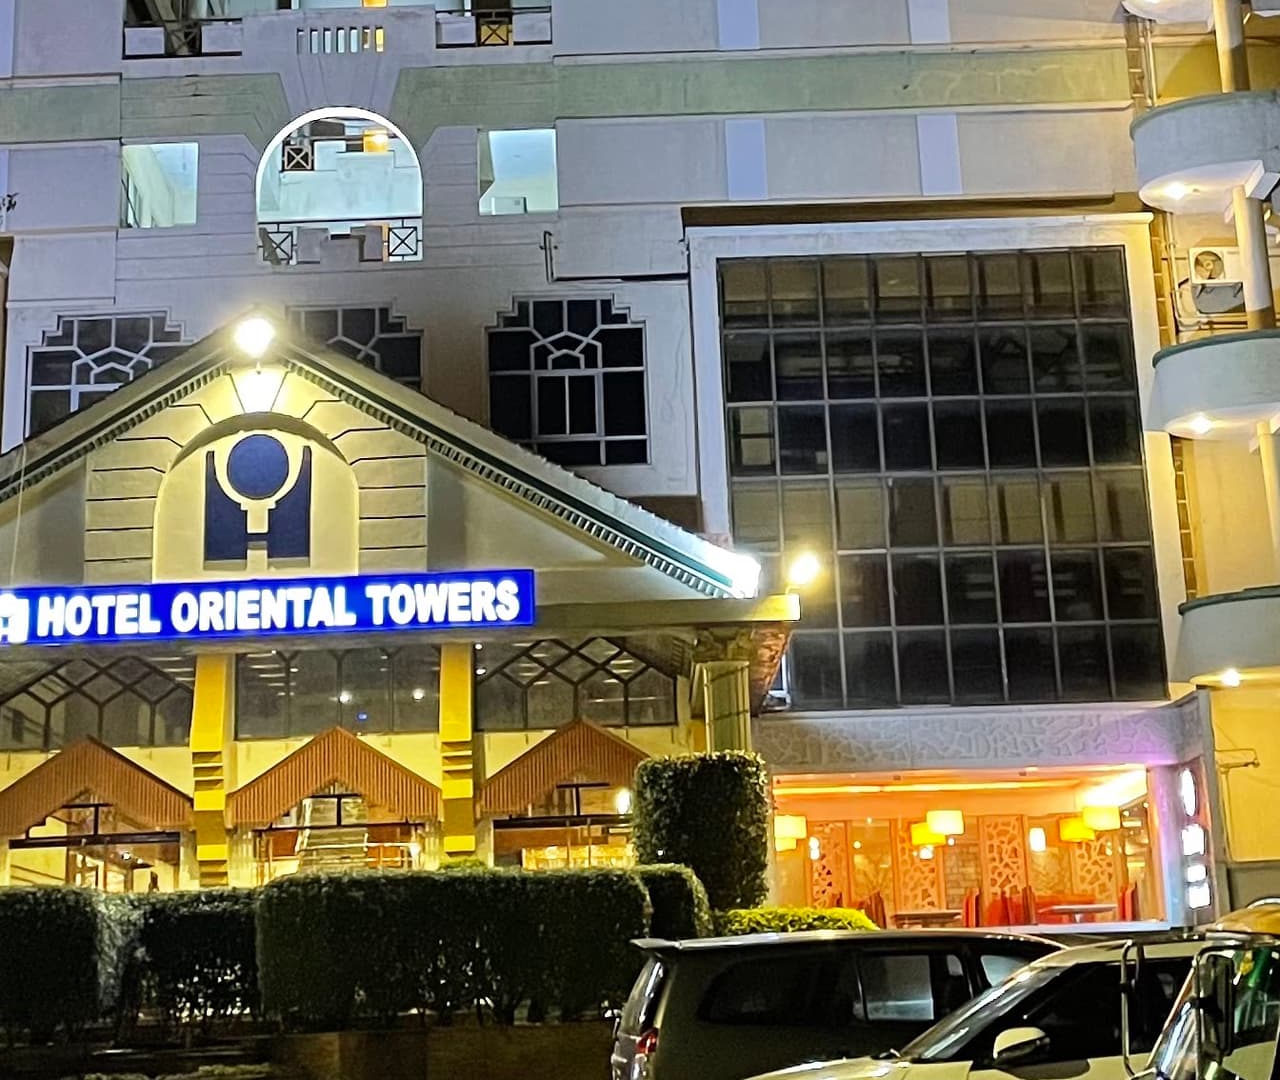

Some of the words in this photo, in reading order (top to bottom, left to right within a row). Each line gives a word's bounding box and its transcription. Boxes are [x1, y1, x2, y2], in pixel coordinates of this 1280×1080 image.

[37, 593, 162, 637] HOTEL
[171, 585, 357, 633] ORIENTAL
[365, 579, 520, 625] TOWERS
